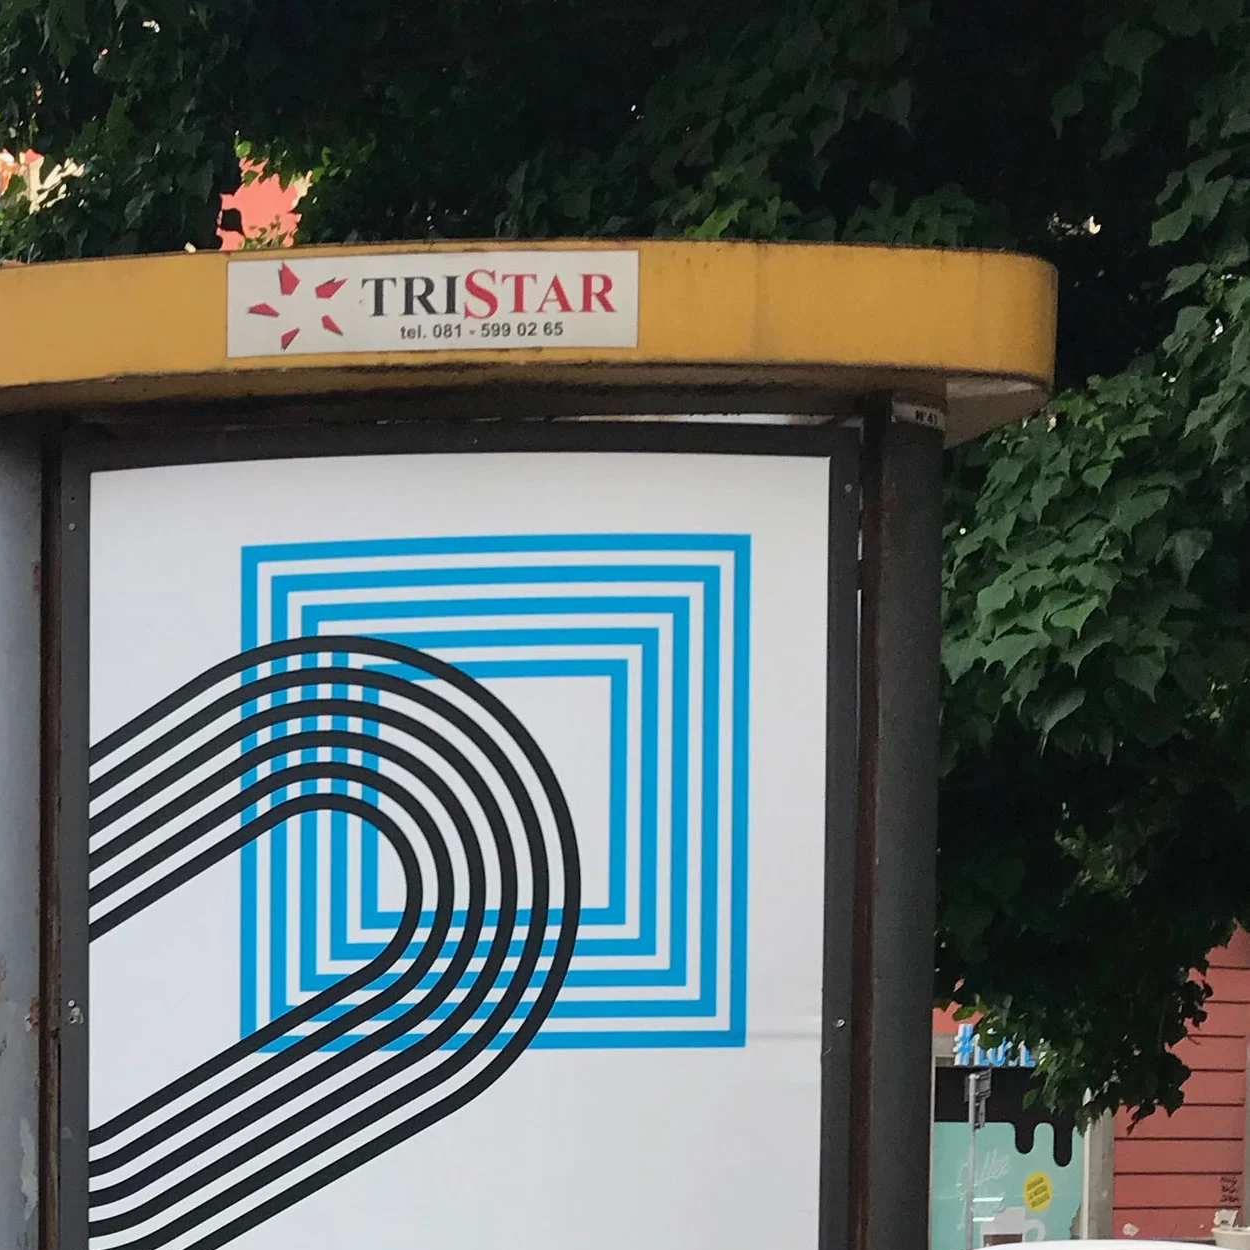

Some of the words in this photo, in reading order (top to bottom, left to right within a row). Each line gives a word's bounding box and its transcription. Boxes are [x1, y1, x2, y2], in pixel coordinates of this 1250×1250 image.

[361, 268, 617, 319] TRISTAR
[400, 323, 427, 340] tel.
[432, 322, 462, 339] 081
[480, 321, 512, 338] 599
[516, 320, 538, 337] 02
[542, 320, 564, 336] 65
